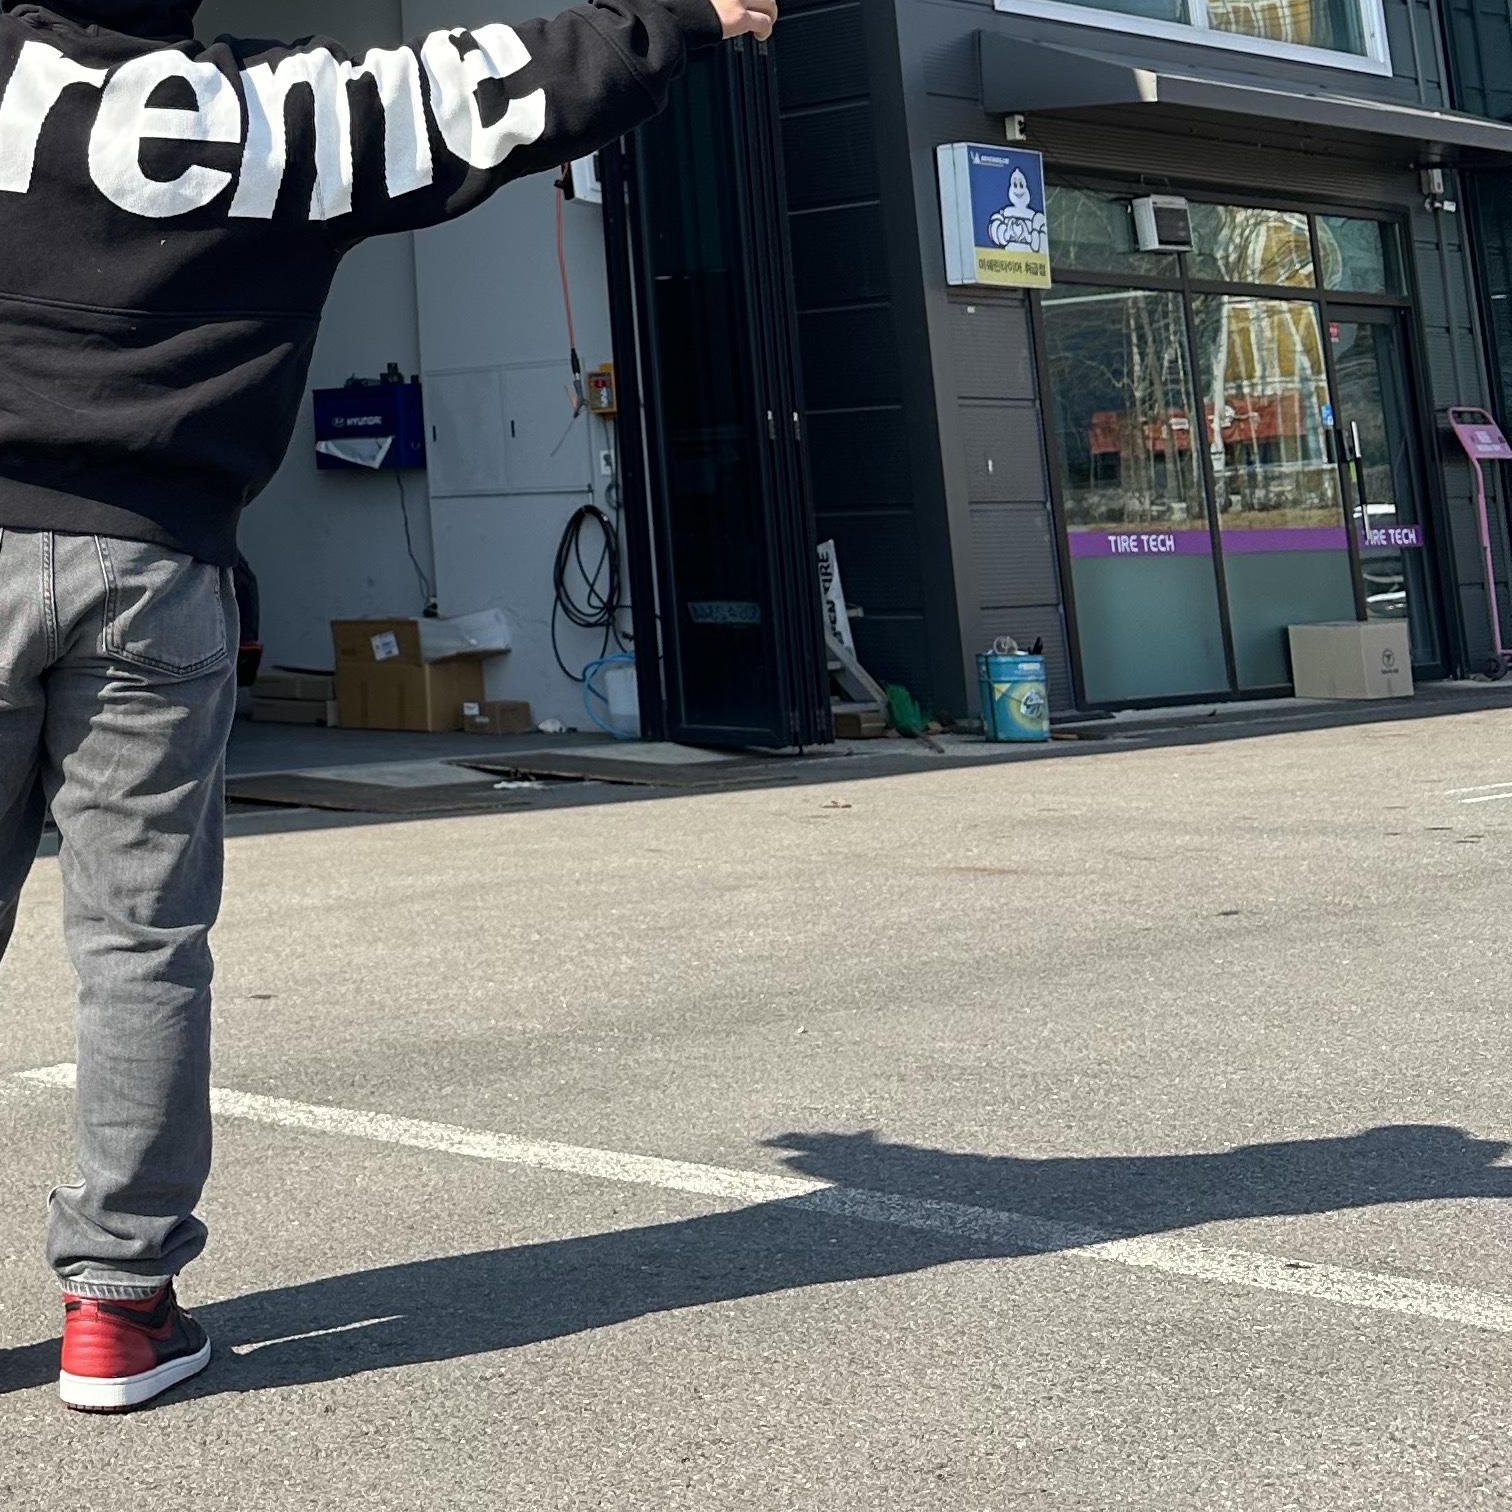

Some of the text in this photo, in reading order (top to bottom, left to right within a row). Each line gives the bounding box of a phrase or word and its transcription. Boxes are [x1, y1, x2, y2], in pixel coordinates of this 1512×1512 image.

[1107, 534, 1176, 554] TIRE TECH
[1388, 528, 1417, 546] TECH
